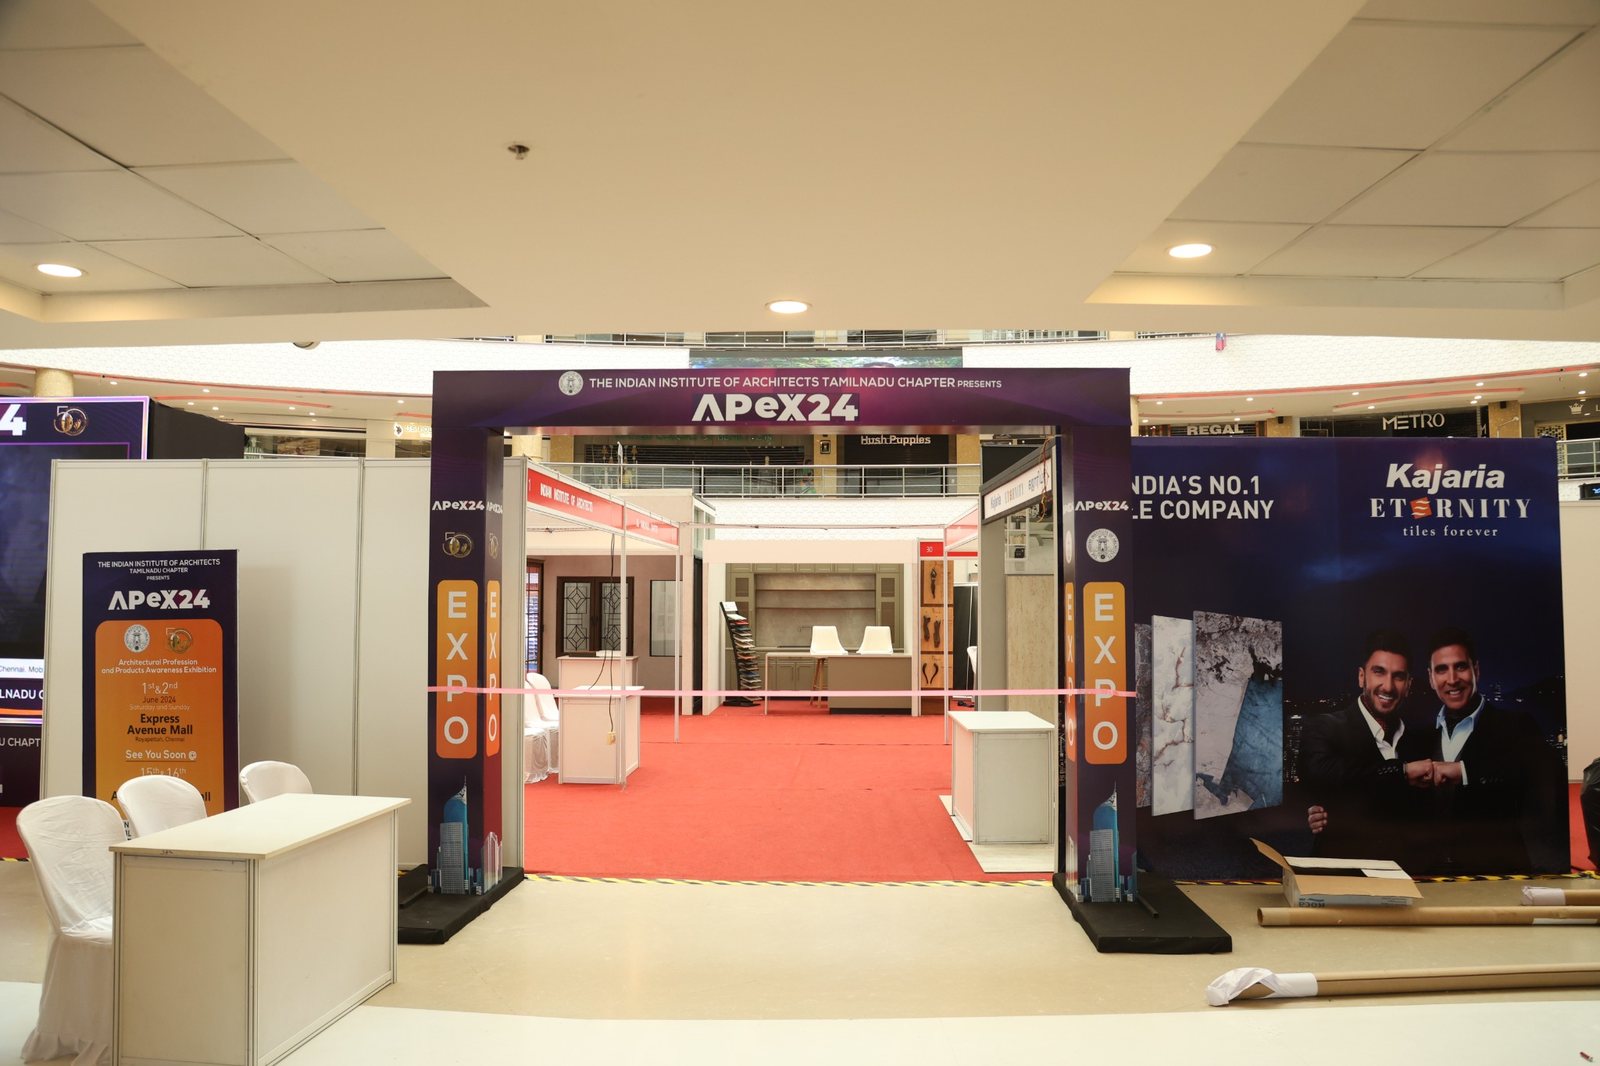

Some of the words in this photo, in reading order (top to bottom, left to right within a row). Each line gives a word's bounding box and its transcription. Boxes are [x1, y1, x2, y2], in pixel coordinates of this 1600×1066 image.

[589, 378, 613, 388] THE
[615, 378, 656, 388] INDIAN
[658, 377, 721, 388] INSTITUTE
[723, 377, 740, 388] OF
[742, 377, 820, 388] ARCHITECTS
[822, 377, 895, 388] TAMILNADU
[897, 377, 956, 388] CHAPTER
[957, 380, 1002, 388] PRESENTS
[1382, 412, 1446, 431] METRO
[1186, 423, 1244, 436] REGAL
[860, 435, 889, 445] Hush
[890, 435, 931, 445] Puppies
[1209, 475, 1260, 495] NO.1
[1386, 463, 1506, 495] Kajaria
[1160, 499, 1274, 520] COMPANY
[1369, 496, 1531, 520] ETERNITY
[1402, 525, 1436, 537] tiles
[1443, 525, 1498, 537] forever
[111, 560, 134, 568] INDIAN
[134, 559, 168, 567] INSTITUTE
[179, 558, 221, 566] ARCHITECTS
[118, 658, 161, 666] Architectural
[443, 590, 469, 745] EXPO
[183, 665, 217, 673] Exhibition
[1092, 592, 1119, 751] EXPO
[142, 695, 159, 703] June
[160, 695, 176, 703] 2024
[140, 713, 180, 726] Express
[127, 725, 167, 735] Avenue
[169, 725, 193, 735] Mall
[125, 749, 143, 759] See
[145, 749, 162, 759] You
[163, 749, 187, 759] Soon
